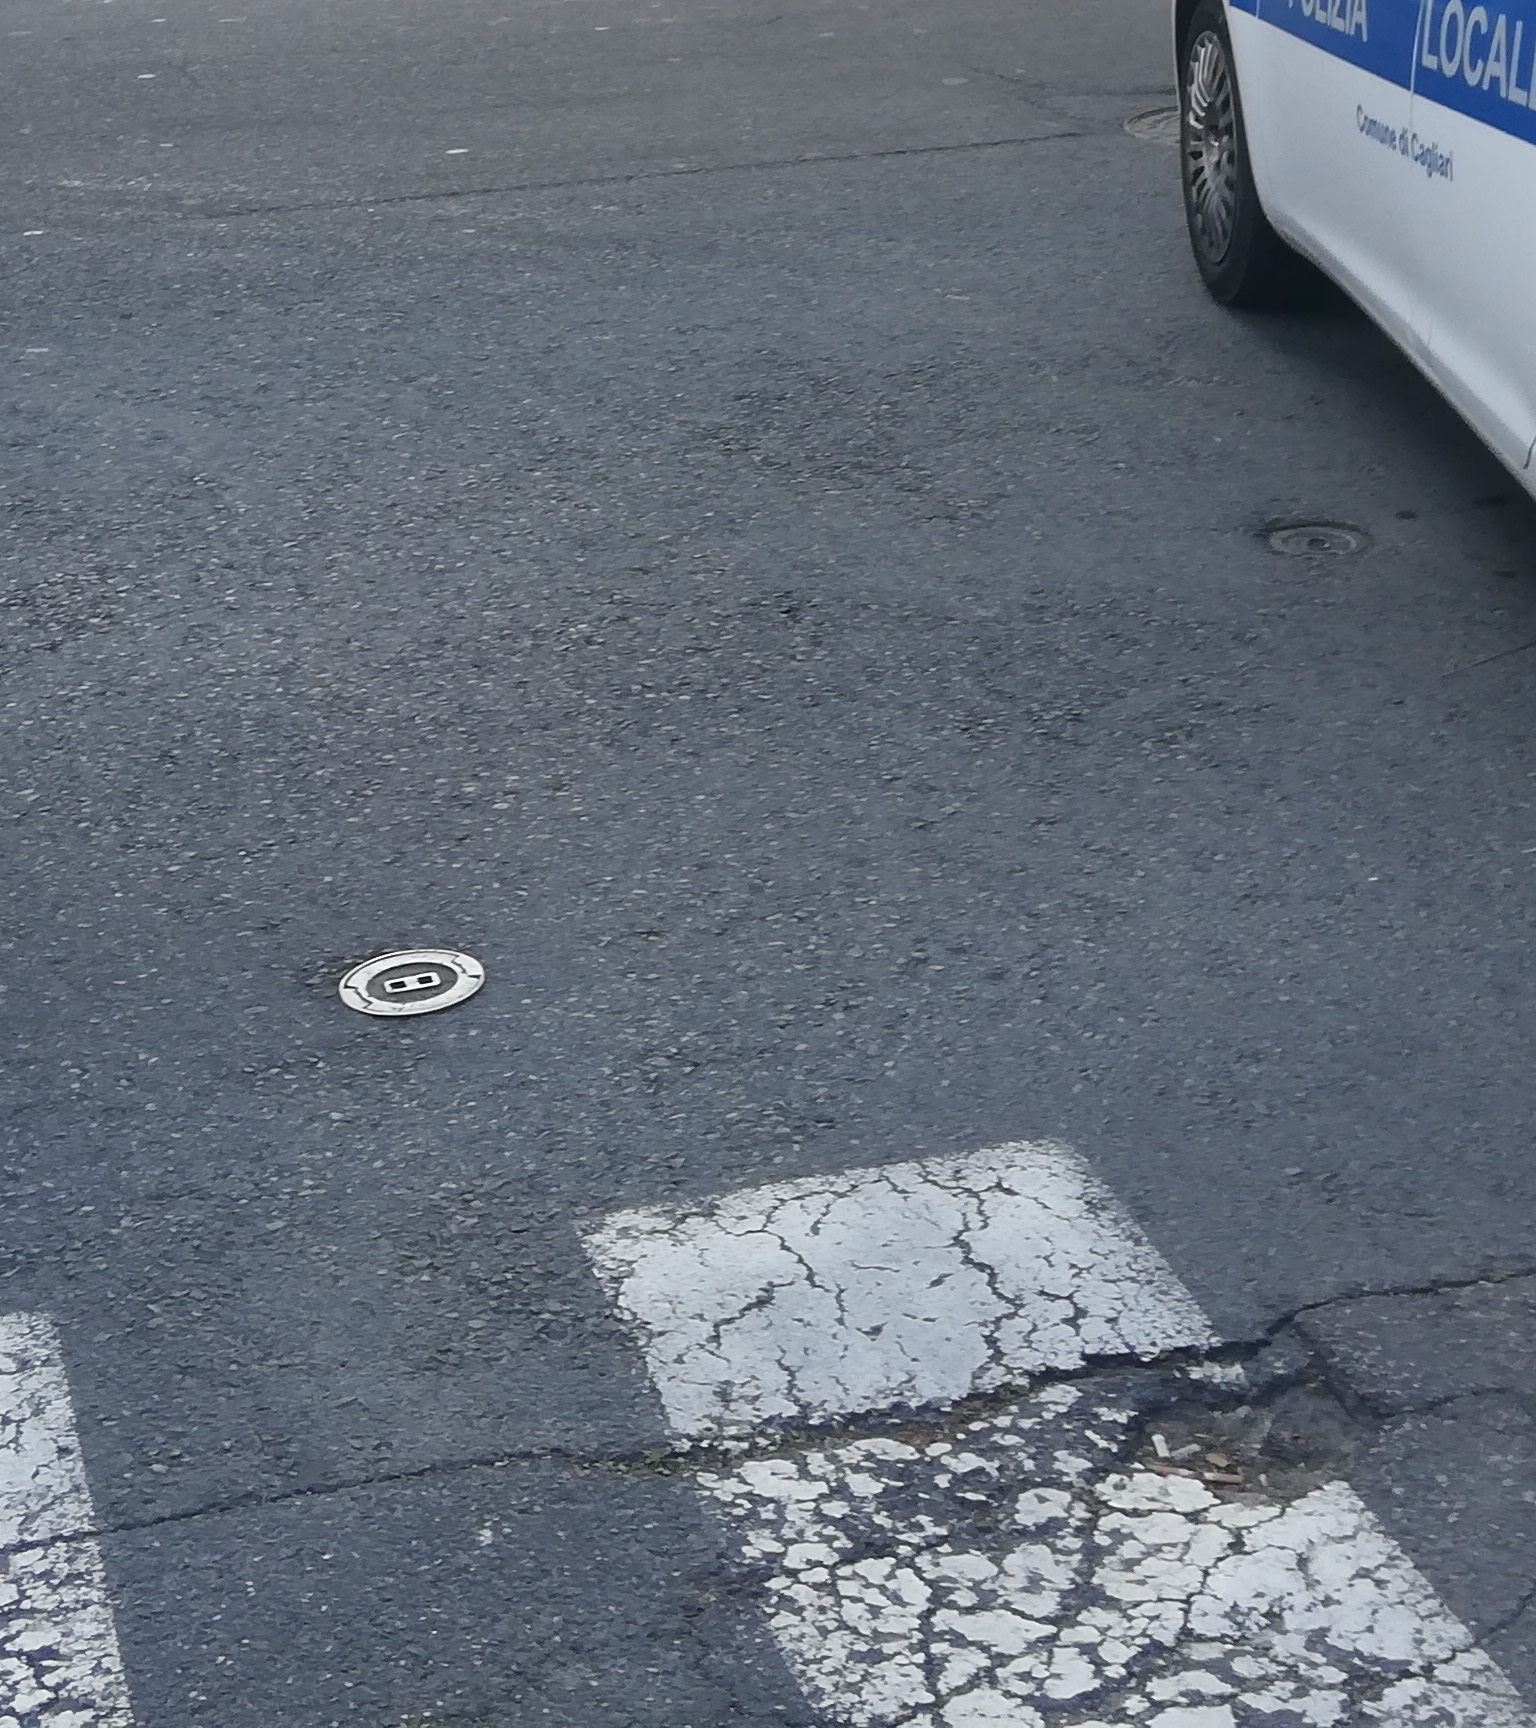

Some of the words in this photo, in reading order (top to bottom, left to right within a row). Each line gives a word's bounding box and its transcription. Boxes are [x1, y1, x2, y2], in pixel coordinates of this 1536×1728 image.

[1356, 104, 1397, 152] Comune
[1398, 126, 1411, 158] di
[1411, 132, 1454, 183] Cagliari
